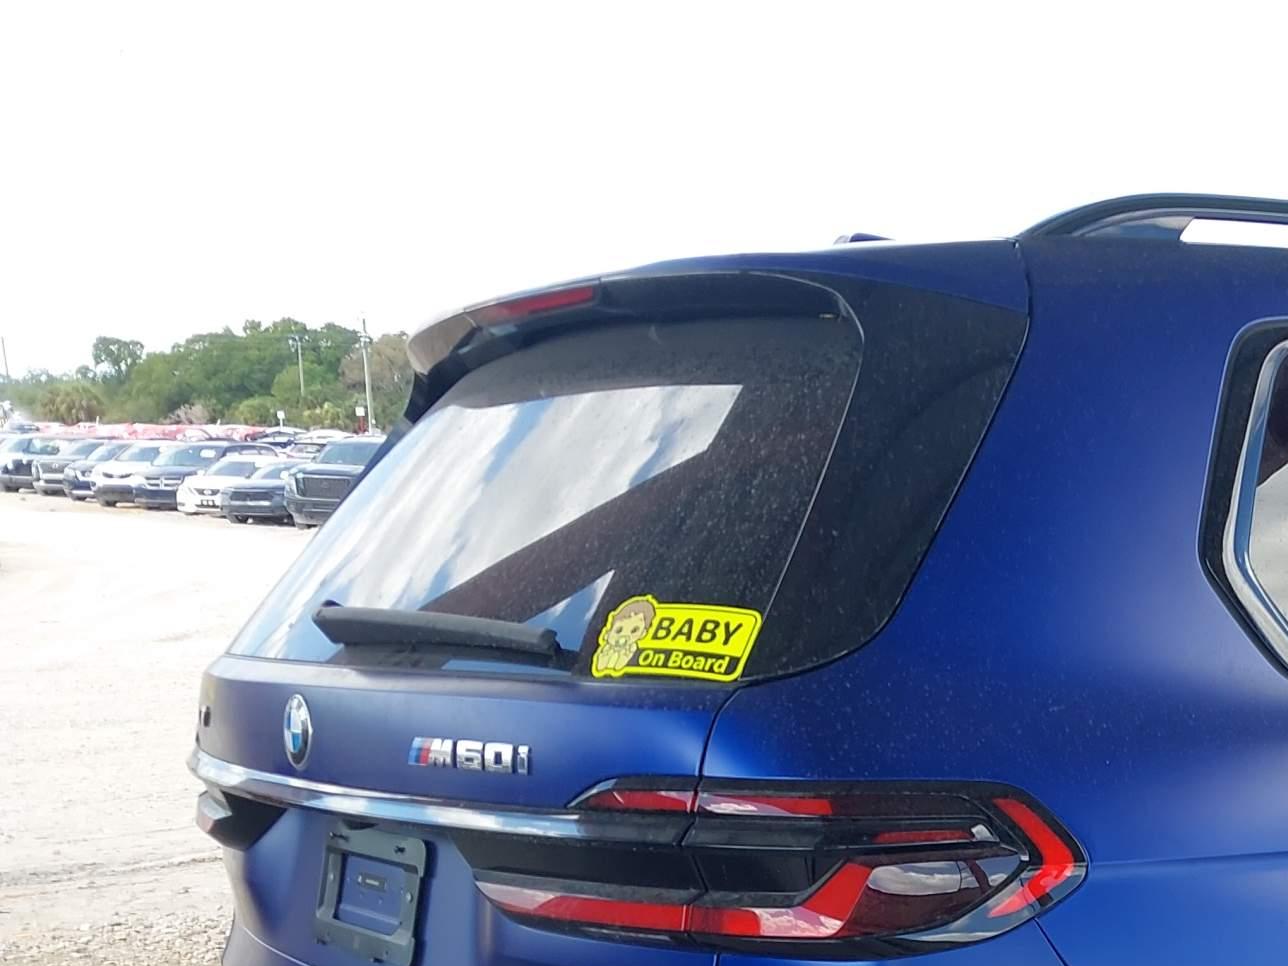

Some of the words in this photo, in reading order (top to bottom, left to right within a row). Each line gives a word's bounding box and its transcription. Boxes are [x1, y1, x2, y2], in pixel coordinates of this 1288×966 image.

[651, 616, 743, 646] BABY
[638, 650, 665, 667] On
[667, 651, 730, 674] Board
[426, 737, 529, 776] M60i
